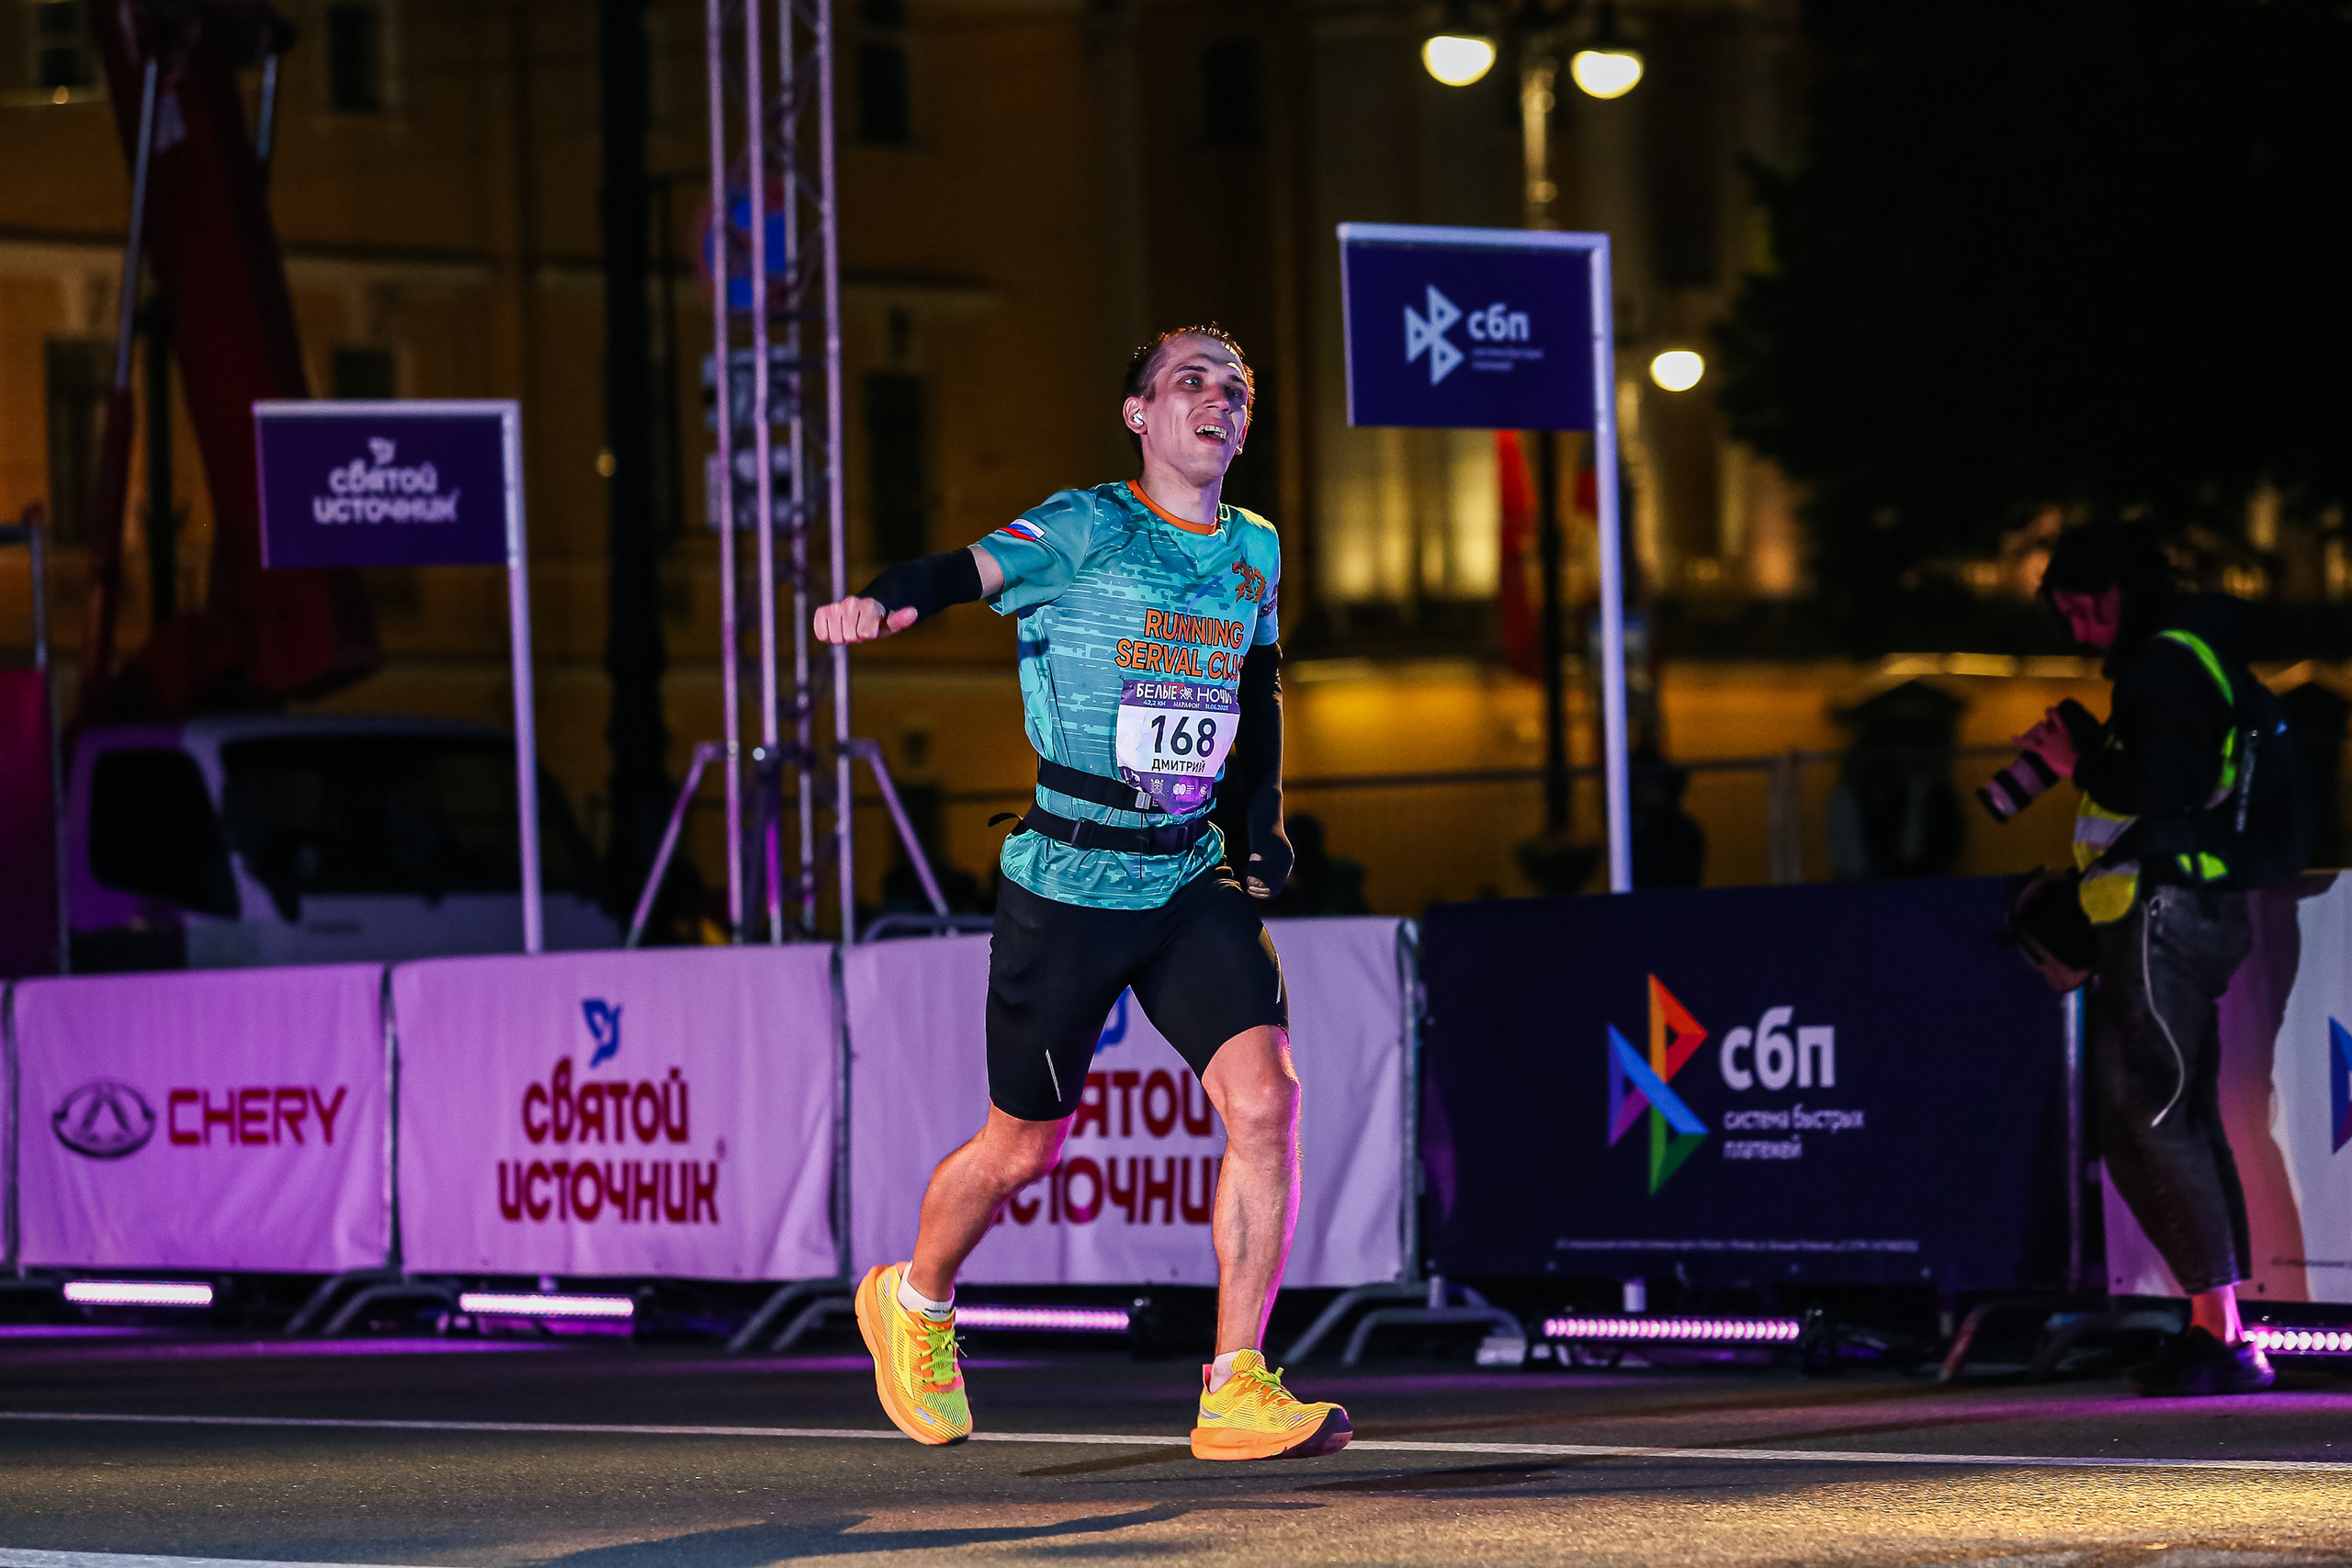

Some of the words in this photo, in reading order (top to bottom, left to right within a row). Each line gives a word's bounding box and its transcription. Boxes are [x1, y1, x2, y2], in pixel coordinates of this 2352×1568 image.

[1466, 301, 1531, 343] сбп
[1144, 608, 1245, 649] RUNNING
[1114, 637, 1203, 678] SERVAL
[1136, 682, 1178, 700] БЕЛЫЕ
[1196, 687, 1232, 705] НОЧИ
[1172, 701, 1201, 709] МАРАФОН
[1151, 715, 1216, 758] 168
[1151, 758, 1206, 773] ДМИТРИЙ
[1719, 1005, 1836, 1091] сбп
[168, 1085, 347, 1145] CHERY
[523, 1056, 688, 1144] святой
[1792, 1102, 1866, 1135] быстрых
[498, 1159, 719, 1224] источник
